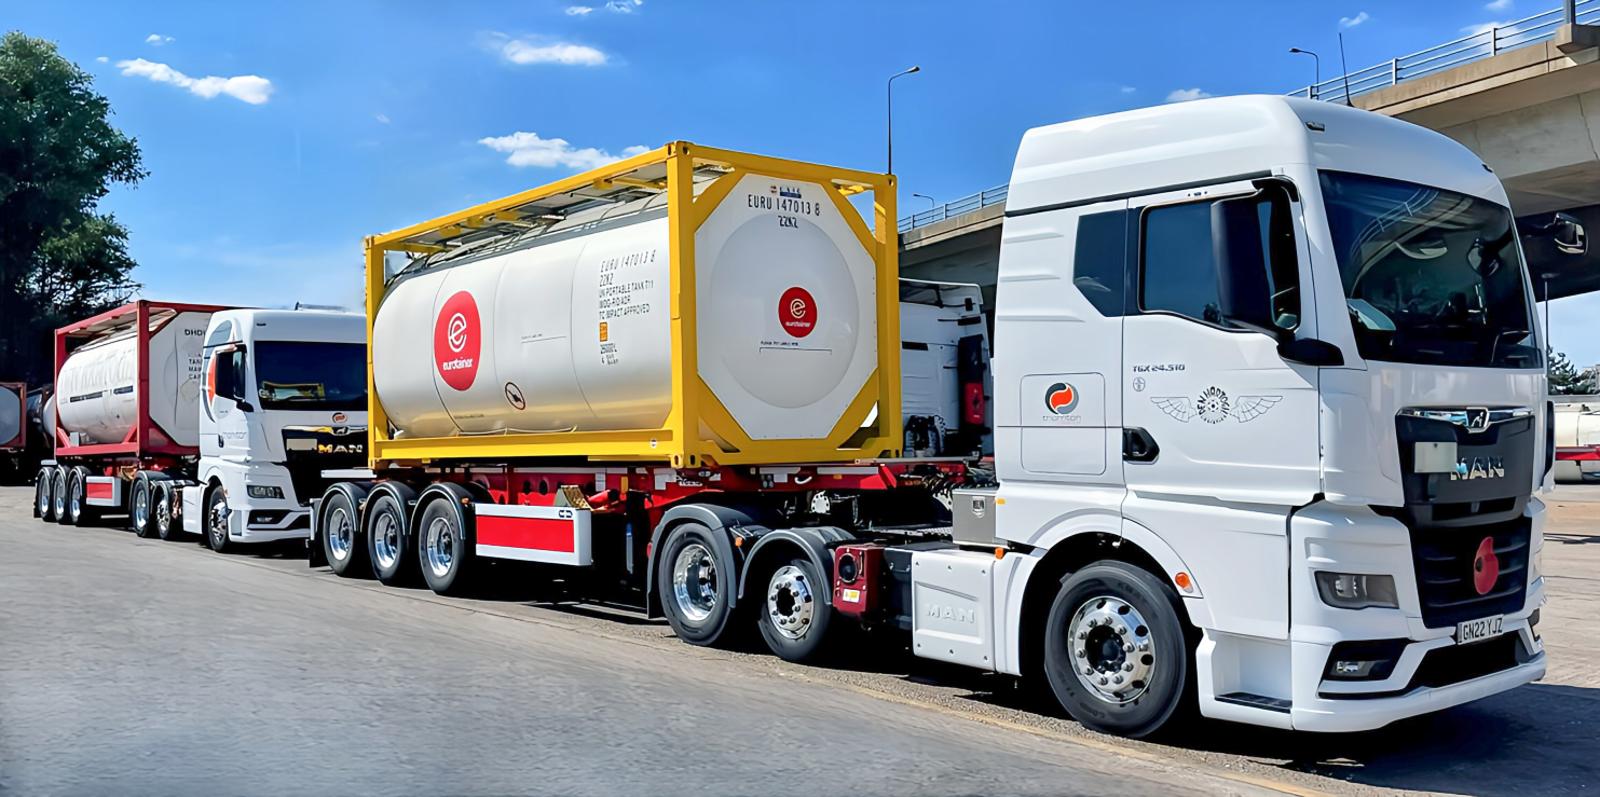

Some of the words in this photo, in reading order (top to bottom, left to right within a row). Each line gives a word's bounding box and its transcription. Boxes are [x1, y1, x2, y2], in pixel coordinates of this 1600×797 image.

[748, 194, 773, 210] EURU
[776, 198, 811, 215] 147013
[814, 202, 821, 217] 8
[778, 215, 798, 228] 22K2
[318, 444, 364, 454] MAN
[1450, 456, 1505, 480] MAN
[925, 604, 976, 624] MAN
[1463, 621, 1486, 640] GN22
[1487, 617, 1503, 636] YJZ
